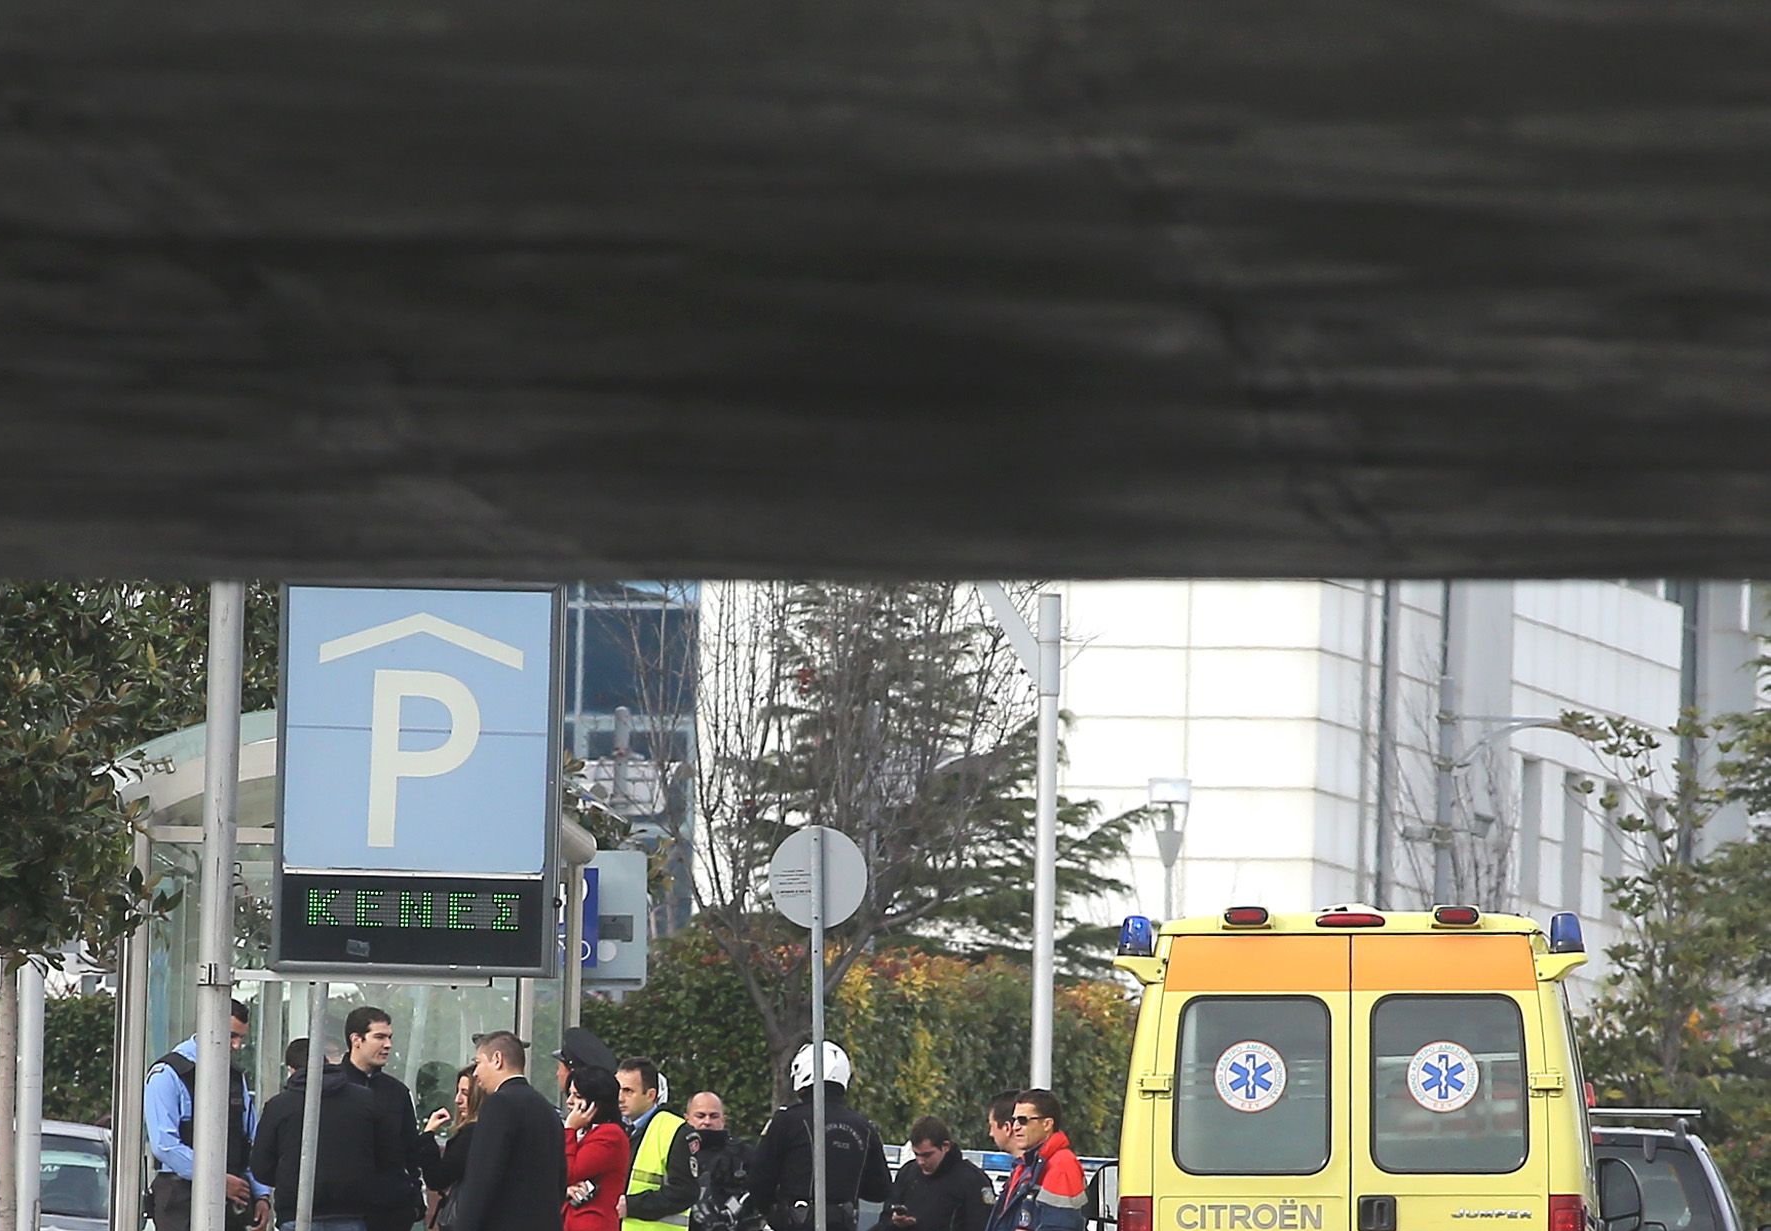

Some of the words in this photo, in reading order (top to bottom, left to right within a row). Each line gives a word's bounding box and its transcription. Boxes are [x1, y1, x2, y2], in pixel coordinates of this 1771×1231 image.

[367, 669, 481, 848] P
[307, 889, 521, 930] ΚΕΝΕΣ
[1176, 1199, 1323, 1230] CITROËN
[1451, 1208, 1532, 1219] JUMPER
